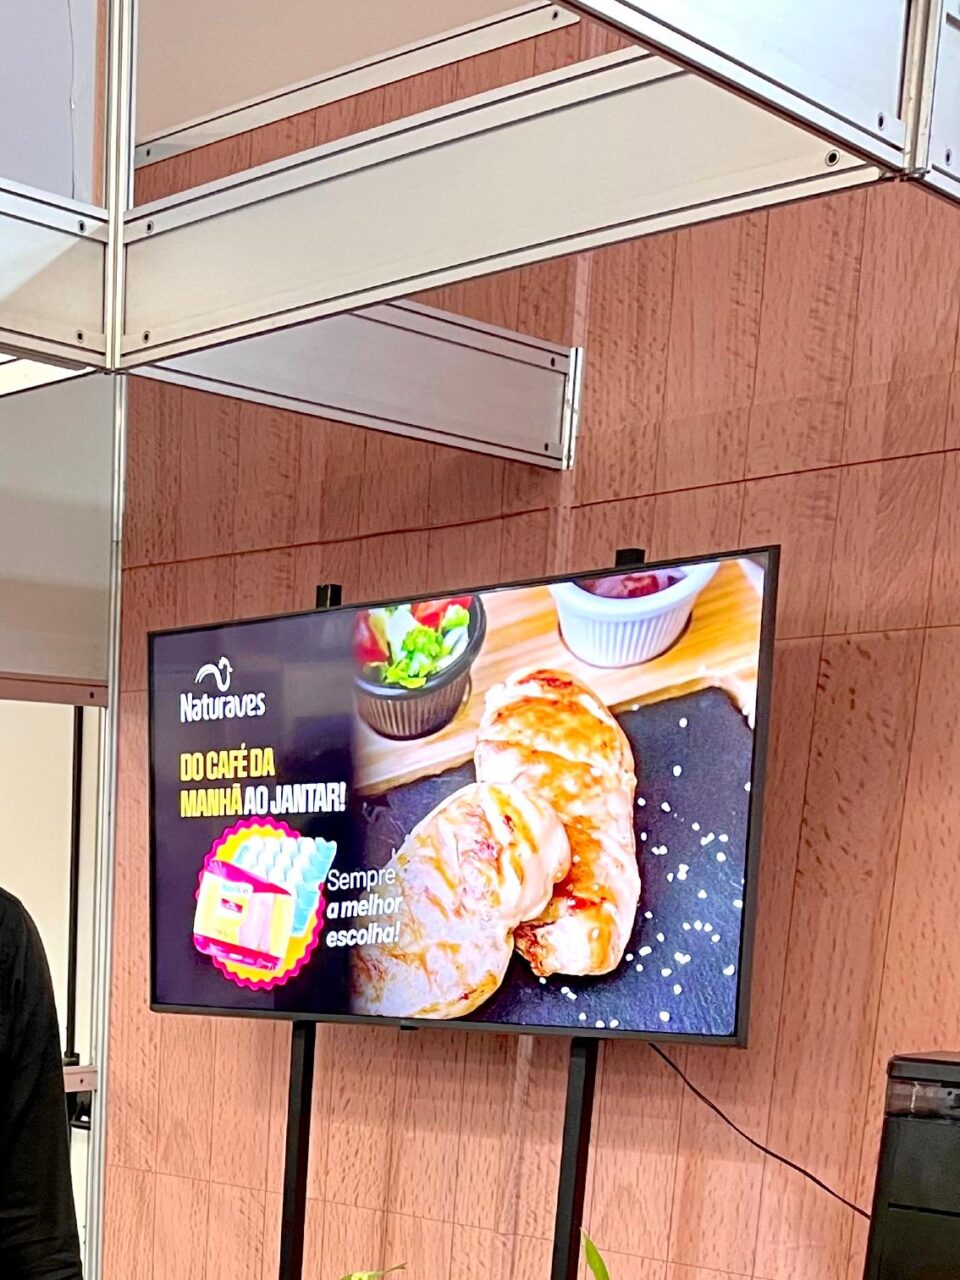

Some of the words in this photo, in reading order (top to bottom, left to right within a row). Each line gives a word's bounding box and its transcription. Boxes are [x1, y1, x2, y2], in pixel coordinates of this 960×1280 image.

[180, 692, 266, 723] Naturaves
[180, 752, 204, 781] DO
[206, 742, 248, 780] CAFÉ
[249, 747, 276, 777] DA
[180, 783, 243, 817] MANHÃ
[243, 785, 269, 815] AO
[270, 781, 346, 814] JANTAR!
[327, 868, 396, 892] Sempre
[326, 901, 339, 919] a
[340, 893, 403, 919] melhor
[326, 920, 401, 948] escolha!
